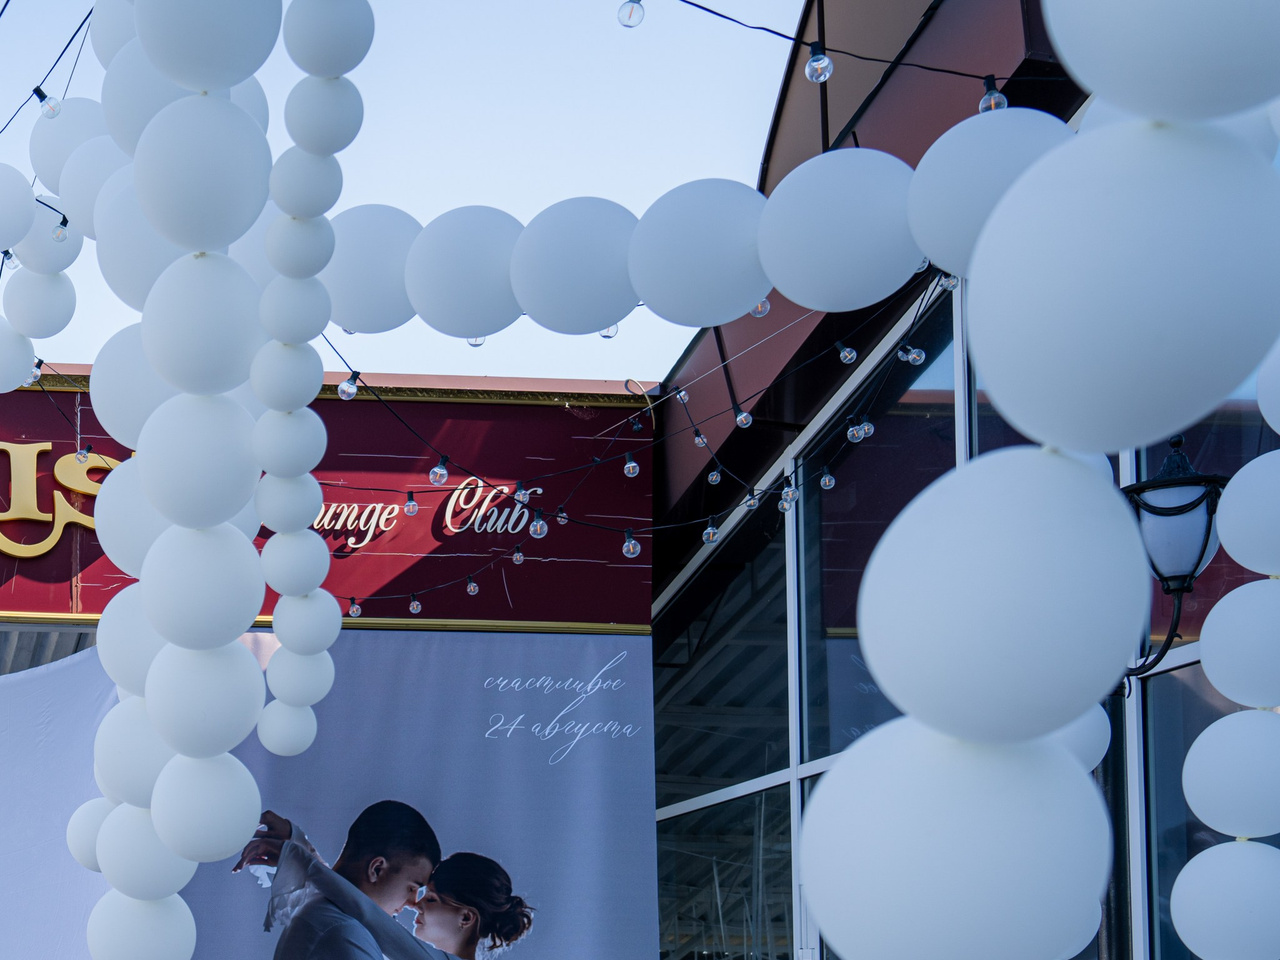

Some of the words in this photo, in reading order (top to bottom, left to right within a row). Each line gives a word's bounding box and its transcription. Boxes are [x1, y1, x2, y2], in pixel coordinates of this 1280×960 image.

[312, 502, 400, 549] unge
[445, 476, 543, 534] Club
[483, 650, 628, 697] счастливое
[484, 713, 525, 739] 24
[531, 694, 641, 765] августа
